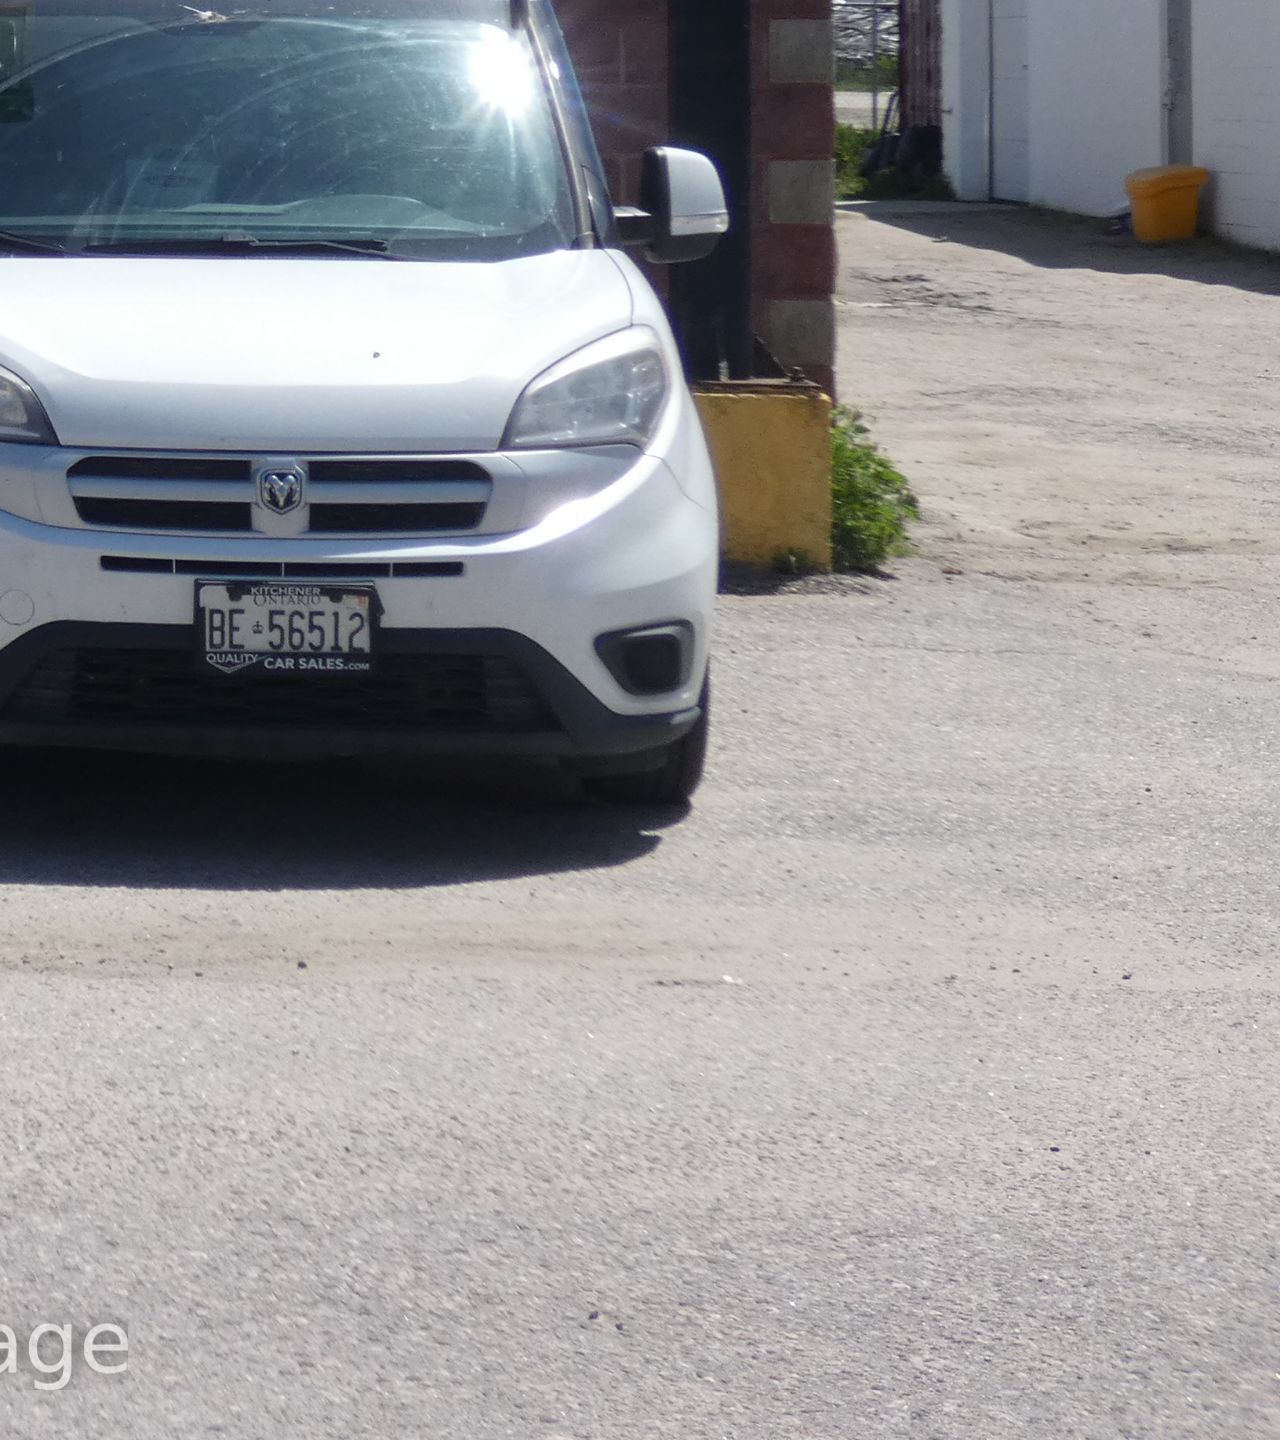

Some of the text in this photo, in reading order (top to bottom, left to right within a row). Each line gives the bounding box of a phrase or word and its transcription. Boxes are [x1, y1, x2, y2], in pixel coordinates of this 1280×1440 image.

[250, 586, 321, 596] KITCHENER
[253, 595, 322, 607] ONTARIO
[208, 608, 367, 653] BE 56512
[206, 653, 259, 664] QUALITY
[264, 657, 297, 670] CAR
